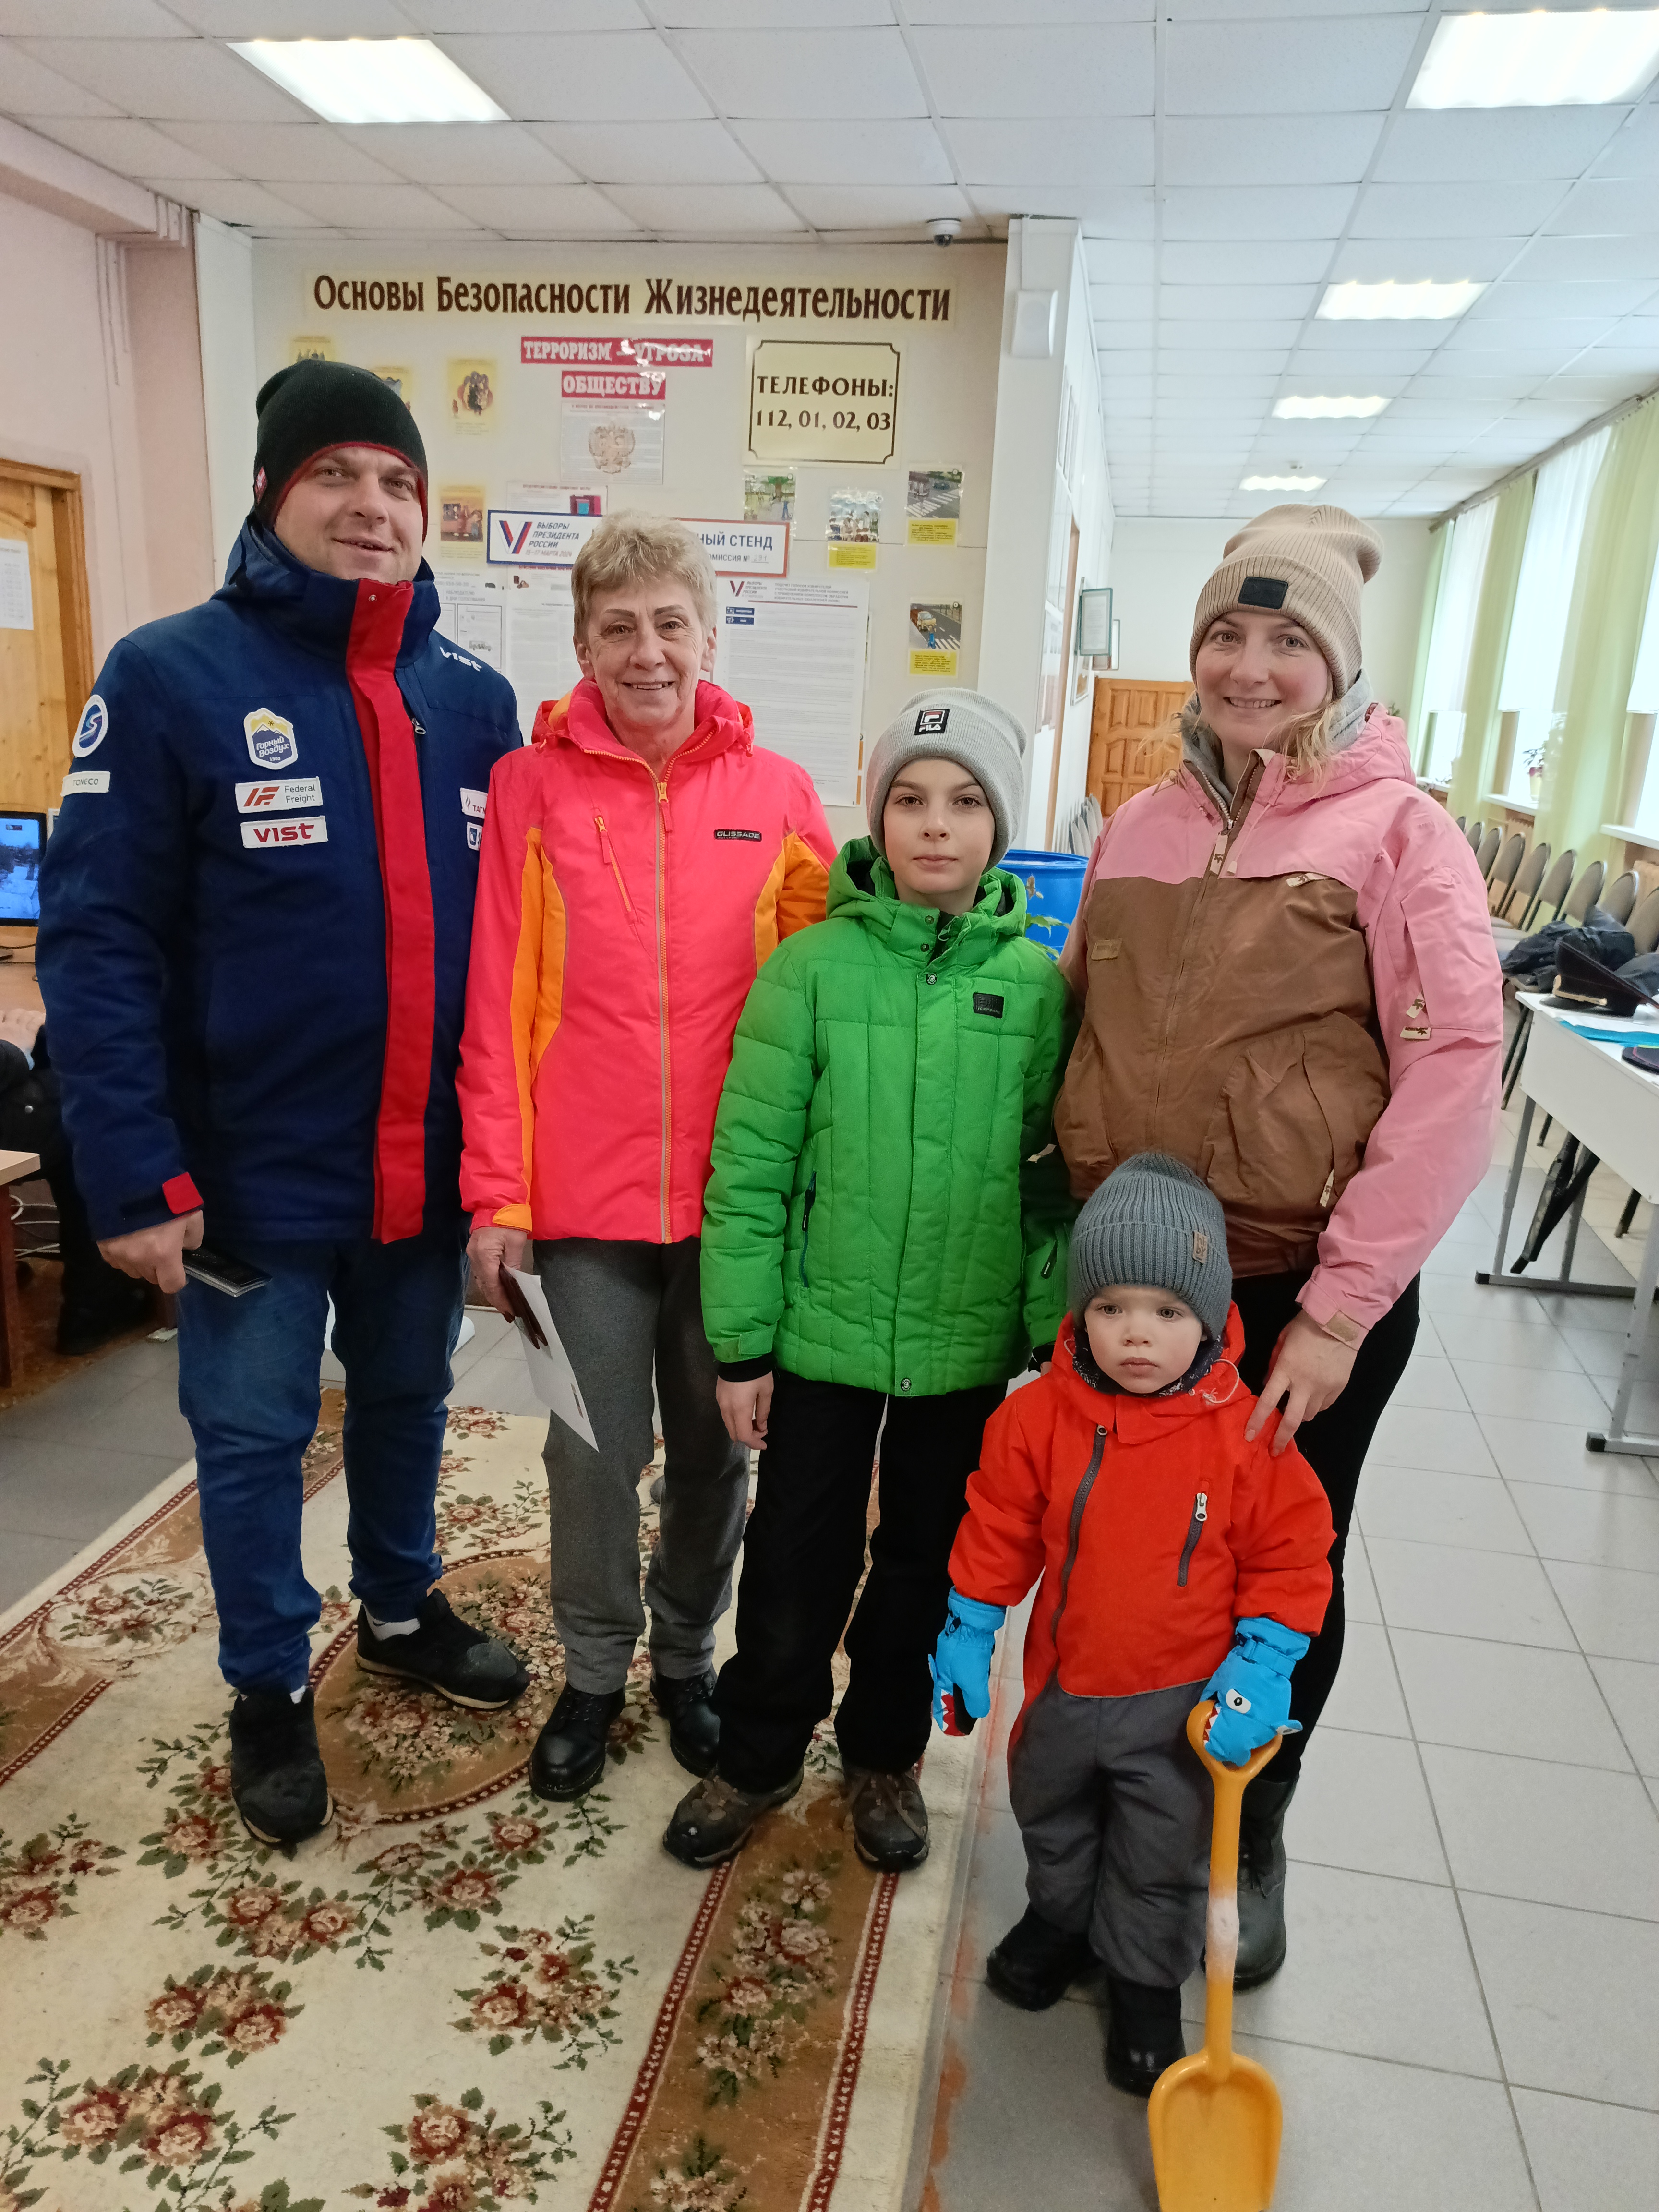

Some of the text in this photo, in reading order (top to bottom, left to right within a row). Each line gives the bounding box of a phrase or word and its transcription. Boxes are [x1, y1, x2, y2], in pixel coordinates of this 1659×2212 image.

[313, 275, 951, 322] Основы Безопасности Жизнедеятельности
[524, 341, 612, 361] ТЕРРОРИЗМ
[634, 342, 704, 362] УГРОЗА
[563, 375, 663, 397] ОБЩЕСТВУ
[757, 376, 893, 397] ТЕЛЕФОНЫ:
[757, 410, 890, 433] 112, 01, 02, 03
[537, 522, 570, 530] ВЫБОРЫ
[532, 531, 579, 541] ПРЕЗИДЕНТА
[730, 534, 773, 551] СТЕНД
[919, 724, 941, 733] FILA
[285, 784, 315, 793] Federal
[286, 795, 315, 804] Freight
